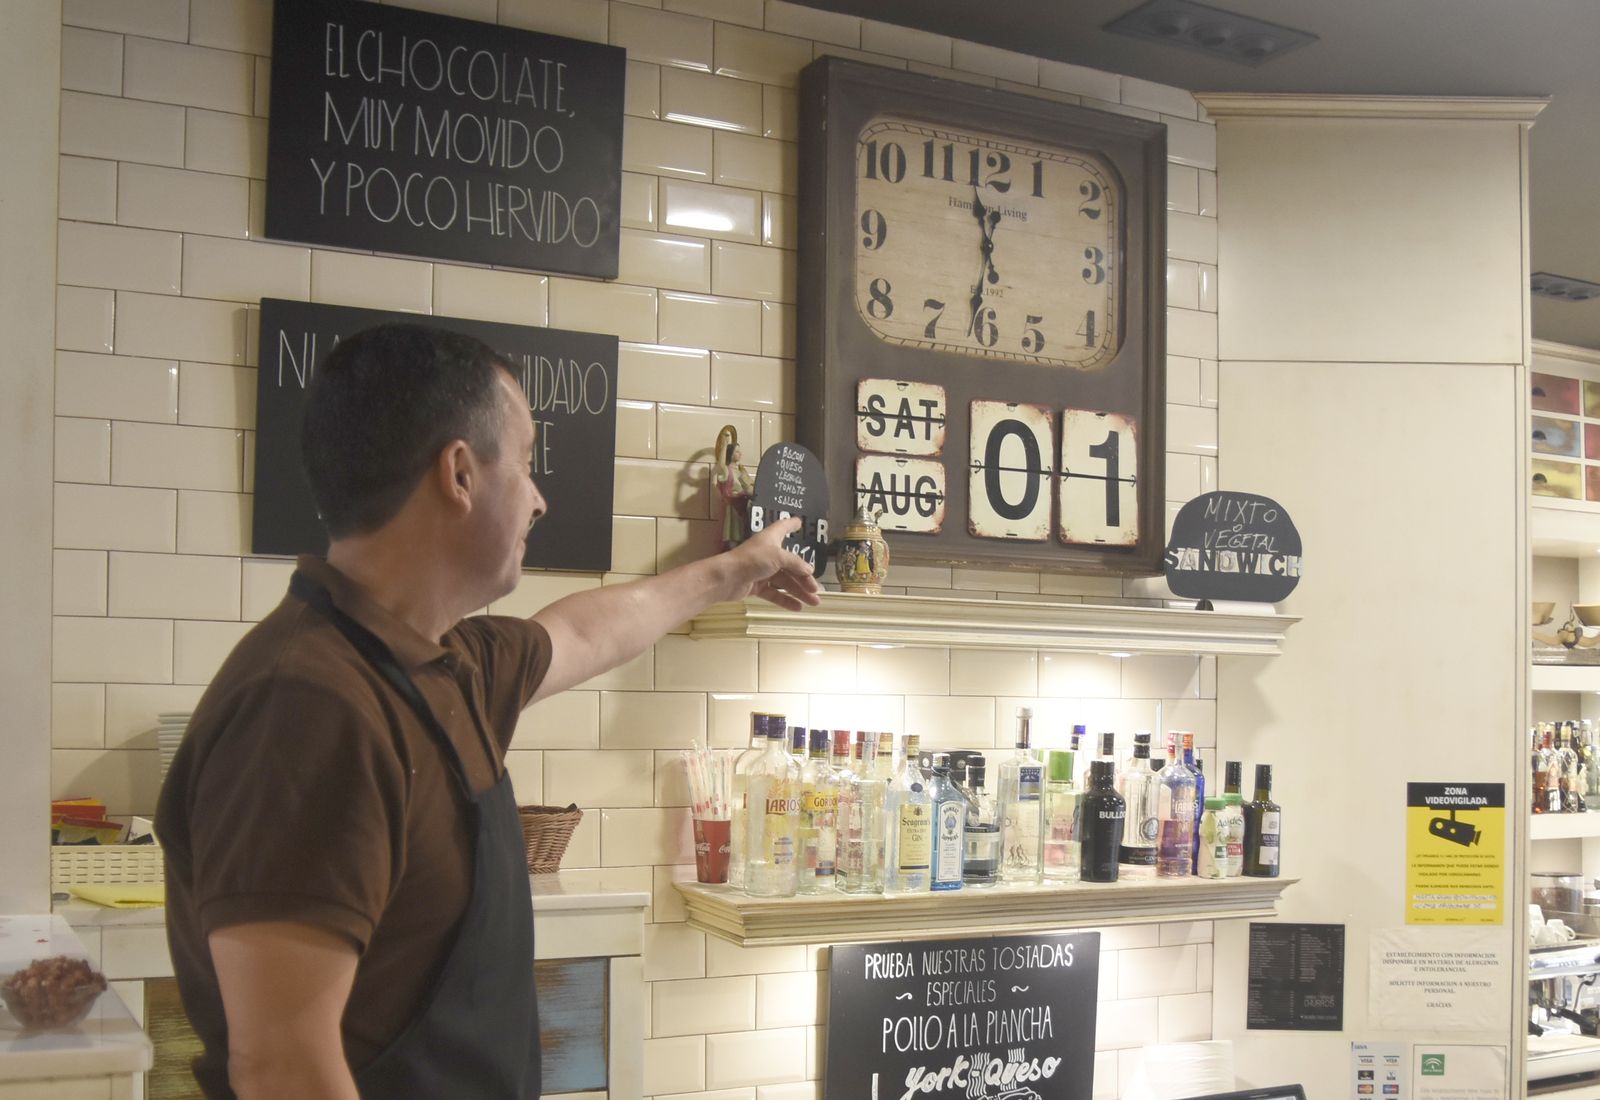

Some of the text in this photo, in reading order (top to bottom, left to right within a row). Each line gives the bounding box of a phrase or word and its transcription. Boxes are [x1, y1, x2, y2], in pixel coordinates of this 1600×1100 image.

[325, 22, 576, 118] EL CHOCOLATE,
[324, 91, 563, 173] MUY MOVIDO
[864, 139, 1046, 198] 10 11 12 1
[310, 158, 601, 248] Y POCO HERVIDO
[1079, 181, 1101, 220] 2
[861, 209, 1105, 285] 9 3
[866, 278, 1100, 354] 8 7 6 5 4
[865, 394, 938, 440] SAT
[866, 472, 938, 518] AUG
[1204, 496, 1278, 524] MIXTO
[1165, 547, 1304, 577] SANDWICH
[1425, 797, 1488, 805] VIDEOVIGILADA
[1444, 787, 1467, 795] ZONA
[865, 943, 1075, 980] PRUEBA NUESTRAS TOSTADAS
[926, 980, 996, 1006] ESPECIALES
[883, 1006, 1053, 1053] POLLO A LA PLANCHA
